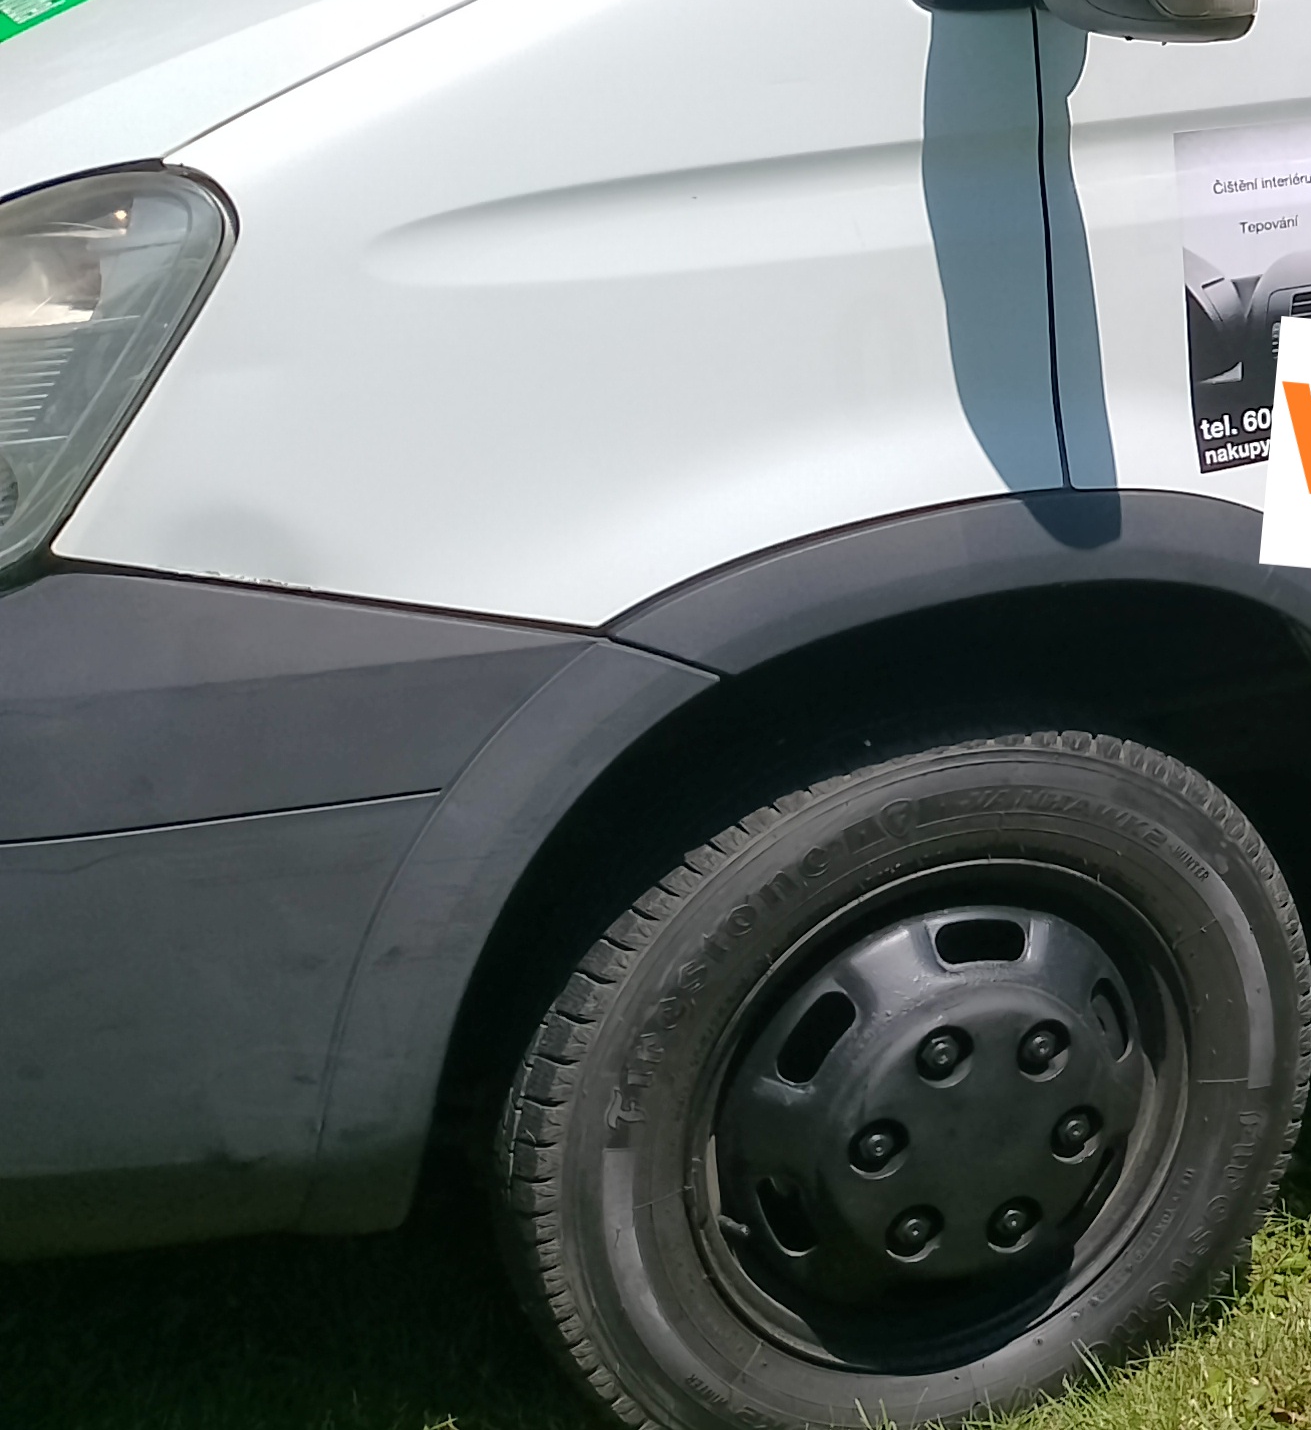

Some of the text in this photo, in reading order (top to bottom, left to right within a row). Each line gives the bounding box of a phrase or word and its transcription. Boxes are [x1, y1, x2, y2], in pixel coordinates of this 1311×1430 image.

[1213, 177, 1258, 196] Čištění
[1239, 215, 1299, 235] Tepování
[1200, 408, 1272, 440] tel. 60
[1204, 438, 1271, 465] nakupy
[1173, 845, 1211, 883] WINTER
[604, 841, 834, 1130] Firestone
